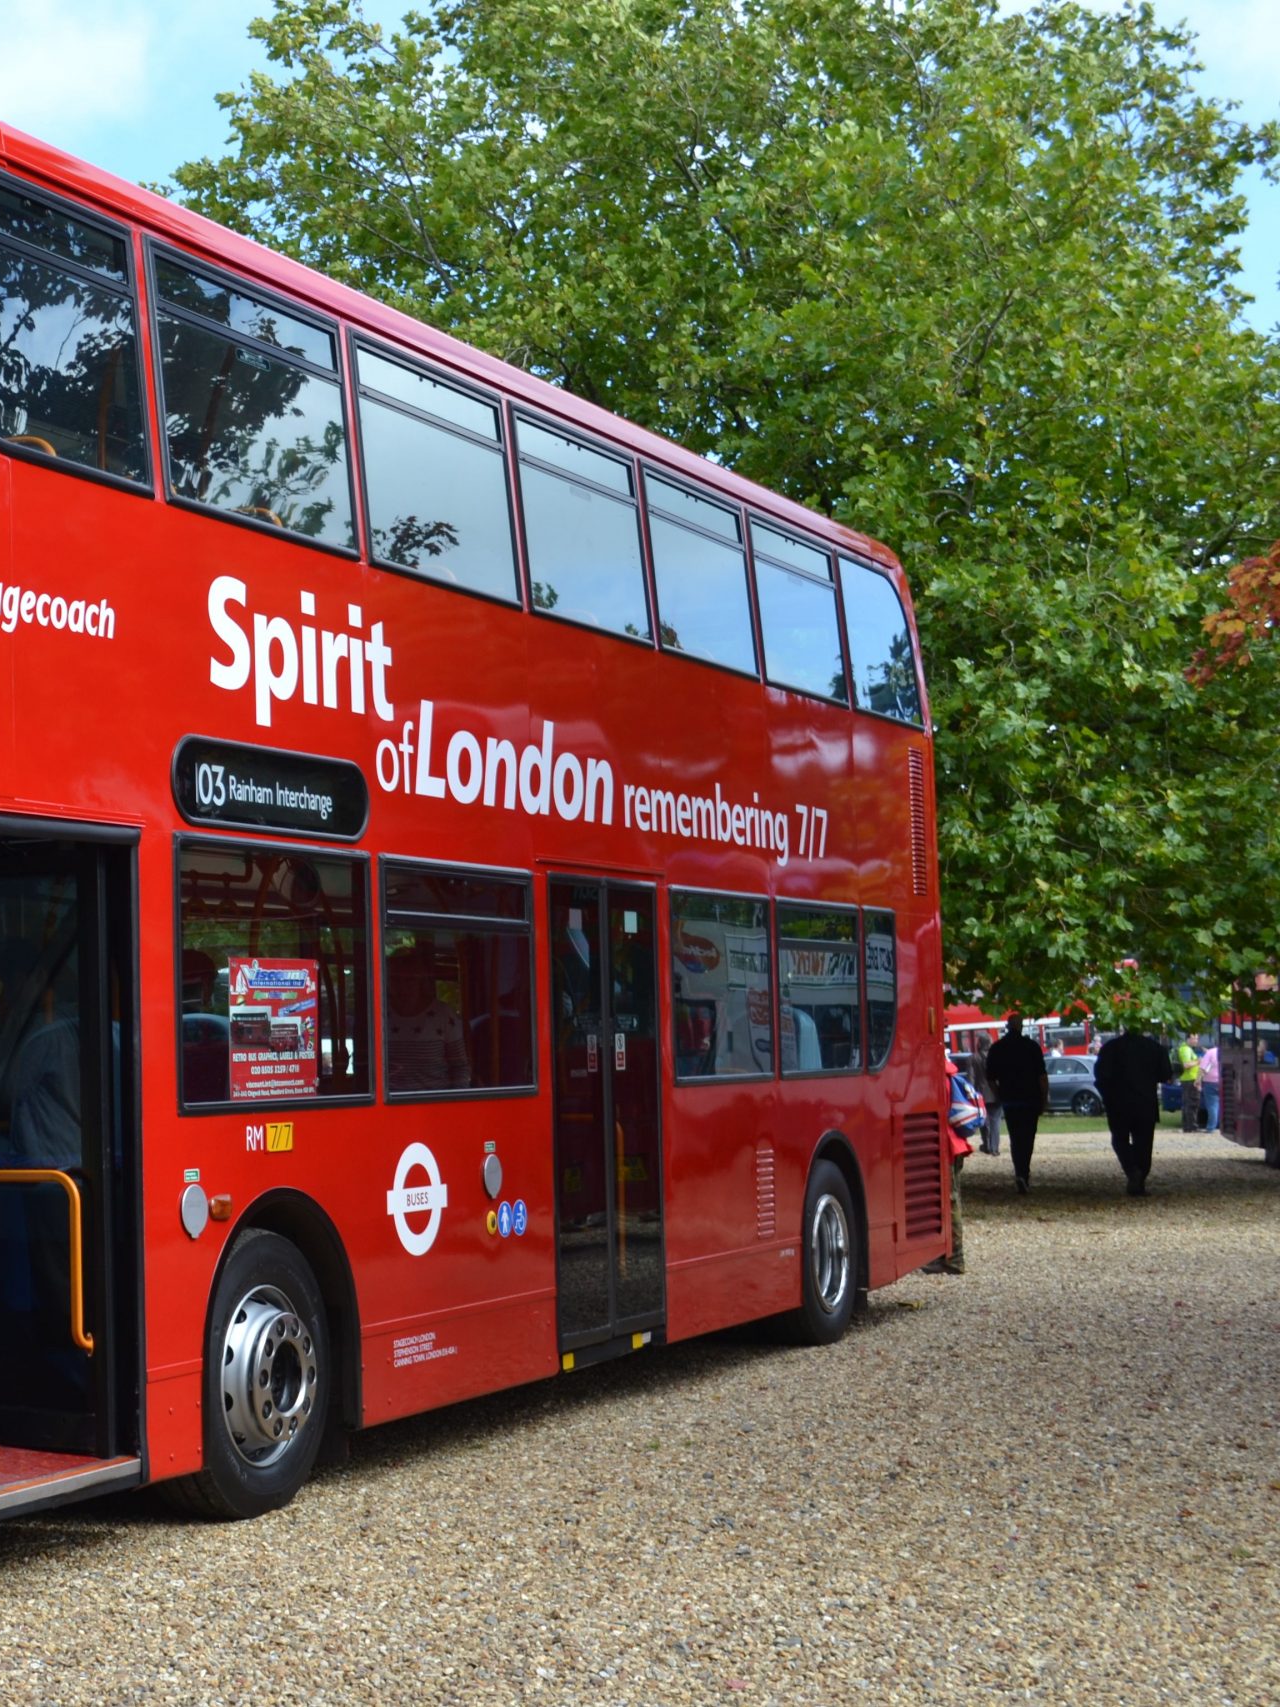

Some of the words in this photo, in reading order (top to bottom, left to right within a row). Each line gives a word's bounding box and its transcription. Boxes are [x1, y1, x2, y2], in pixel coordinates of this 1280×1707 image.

[208, 576, 395, 728] Spirit
[229, 775, 273, 805] Rainham
[276, 781, 333, 820] Interchange
[376, 721, 414, 795] of
[416, 700, 614, 826] London
[624, 783, 789, 868] remembering
[796, 804, 828, 864] 7/7
[246, 1125, 264, 1151] RM
[406, 1191, 429, 1207] BUSES
